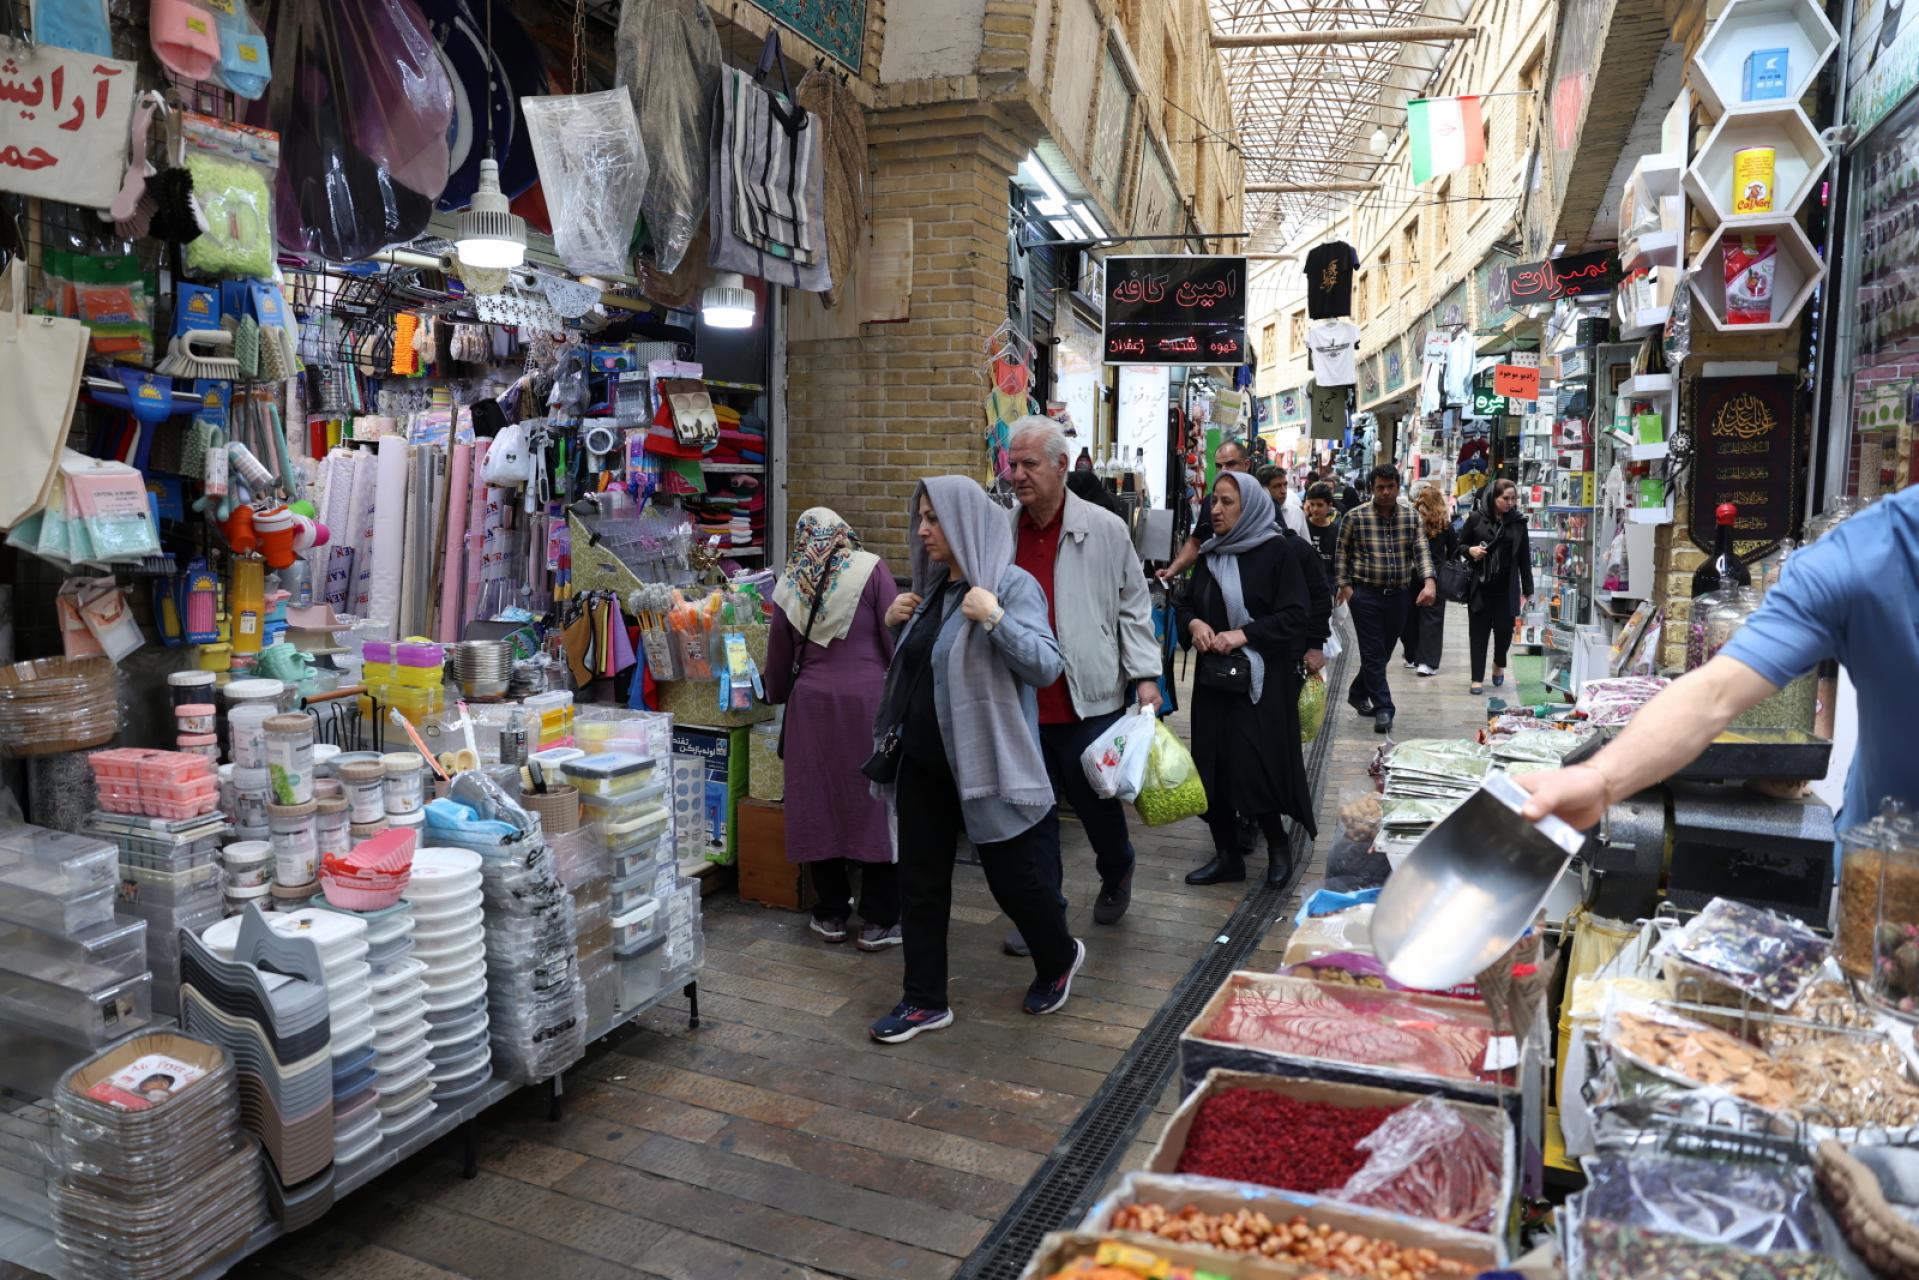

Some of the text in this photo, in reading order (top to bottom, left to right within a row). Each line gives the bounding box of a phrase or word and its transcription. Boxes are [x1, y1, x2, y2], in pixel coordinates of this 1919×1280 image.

[0, 145, 58, 170] حم
[1113, 269, 1236, 307] امین کافه
[1109, 338, 1145, 354] زعفران
[1210, 340, 1238, 354] قهوه
